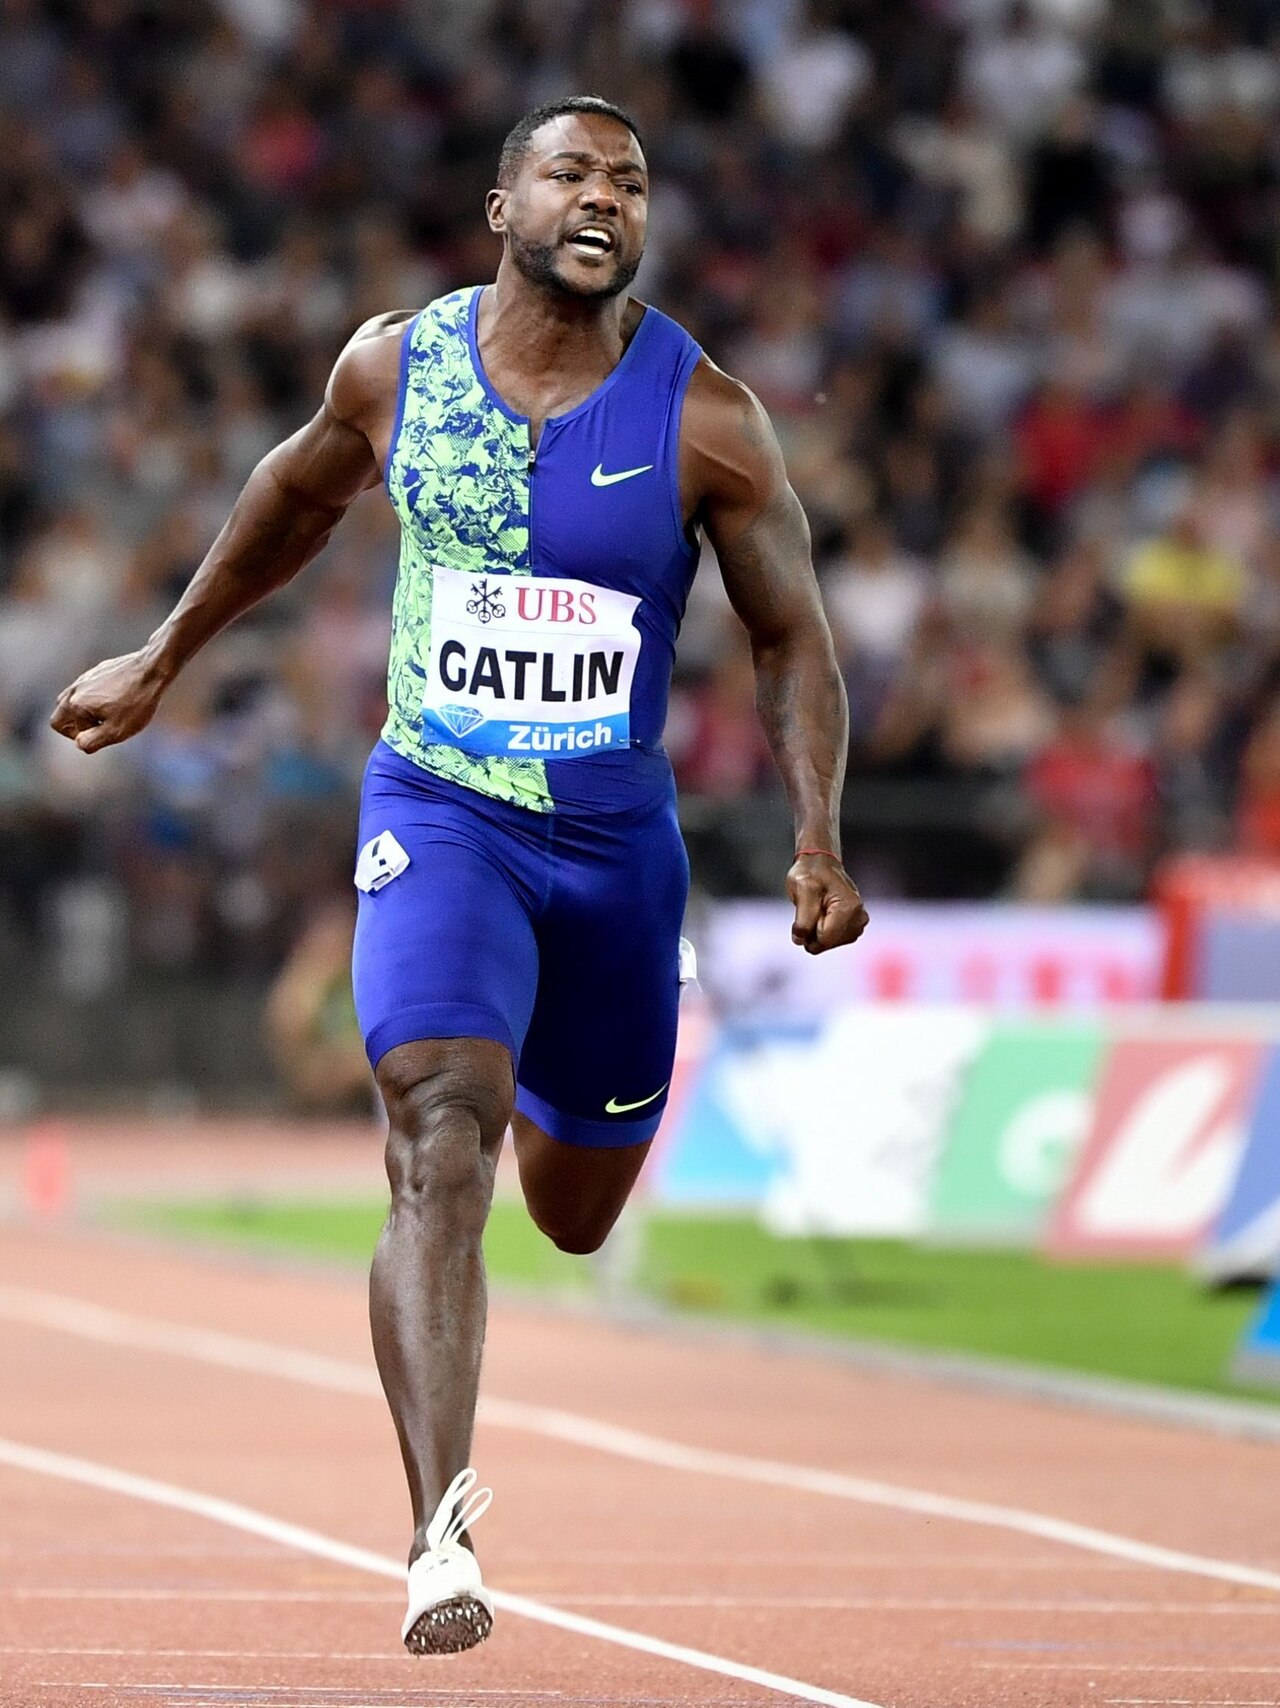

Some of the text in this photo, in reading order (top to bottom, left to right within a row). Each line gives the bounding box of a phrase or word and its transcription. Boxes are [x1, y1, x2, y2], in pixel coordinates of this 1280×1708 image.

[515, 587, 597, 625] UBS
[439, 639, 625, 703] GATLIN
[507, 722, 612, 751] Zürich
